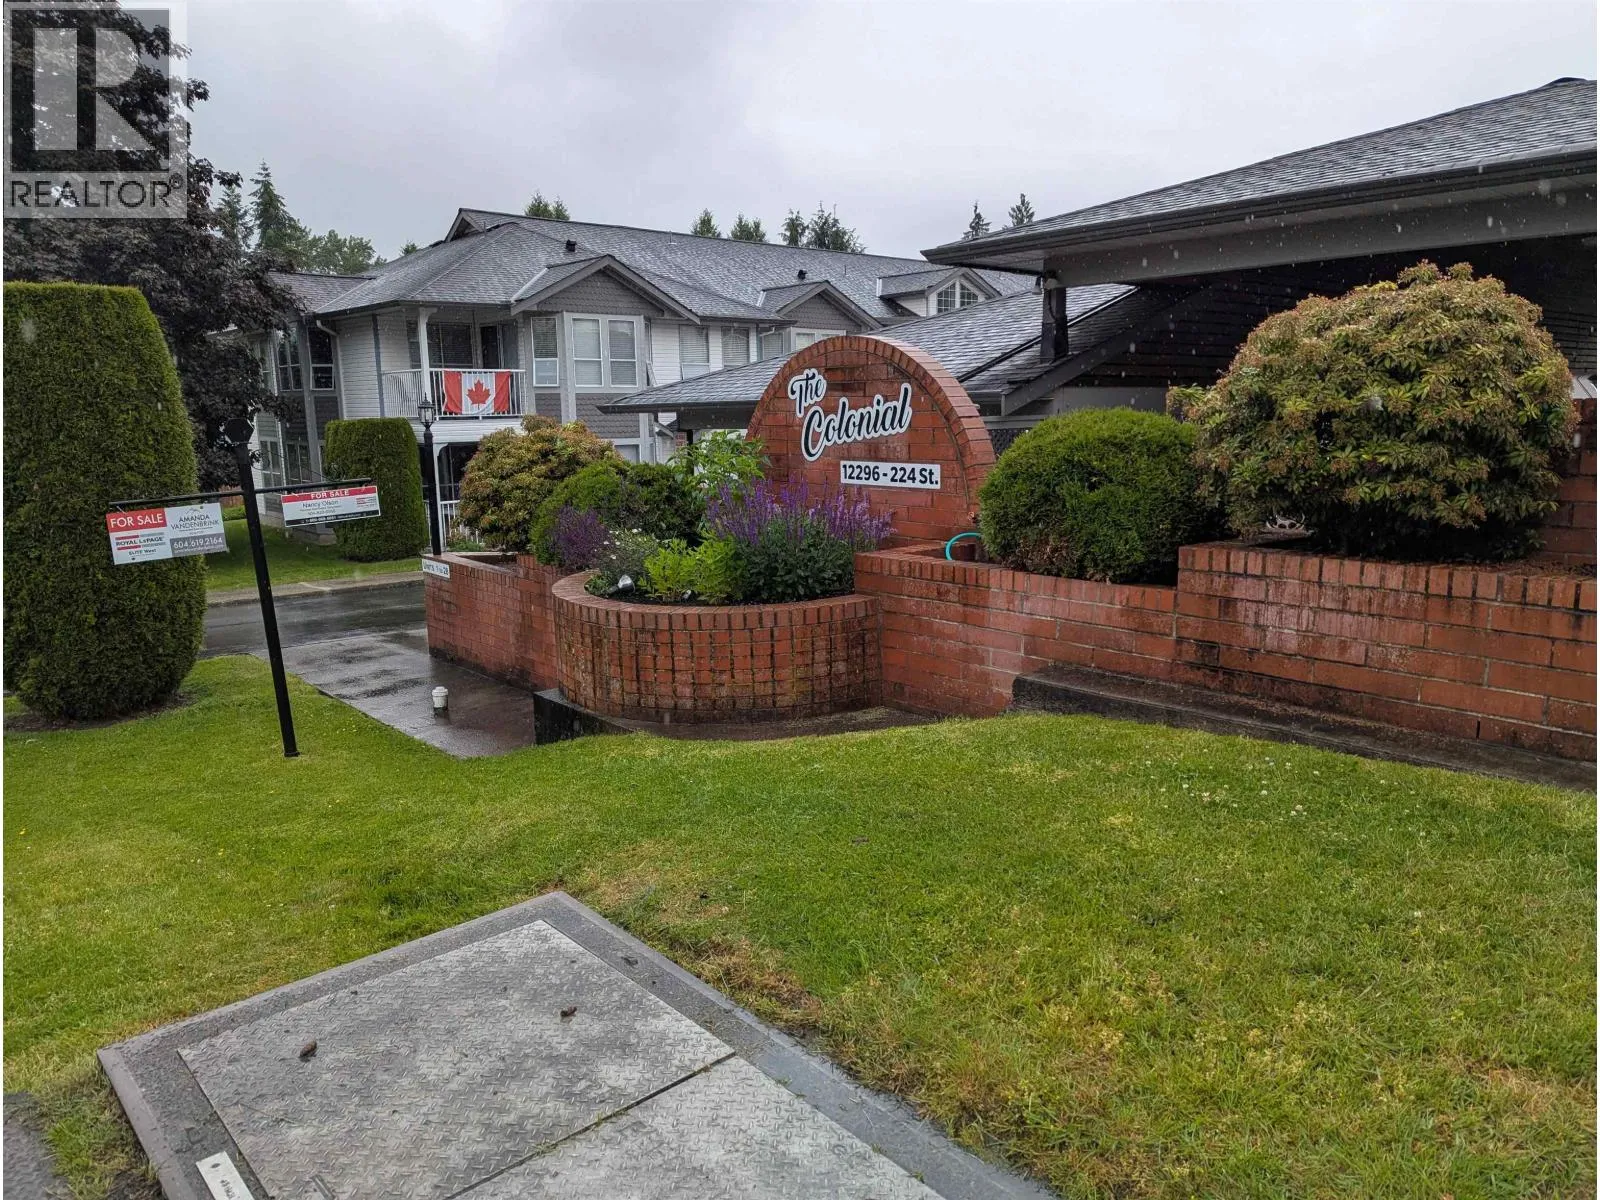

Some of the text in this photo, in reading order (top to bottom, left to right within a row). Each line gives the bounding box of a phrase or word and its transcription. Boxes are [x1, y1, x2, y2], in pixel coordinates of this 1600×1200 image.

[790, 371, 825, 415] The
[803, 386, 911, 458] Colonial
[842, 464, 880, 482] 12296
[890, 466, 916, 484] 224
[919, 468, 939, 486] St.
[329, 490, 350, 498] SALE
[302, 501, 321, 509] Nancy
[110, 513, 164, 529] FOR SALE
[178, 514, 210, 523] AMANDA
[170, 519, 220, 530] VANDENBRINK
[115, 539, 138, 547] ROYAL
